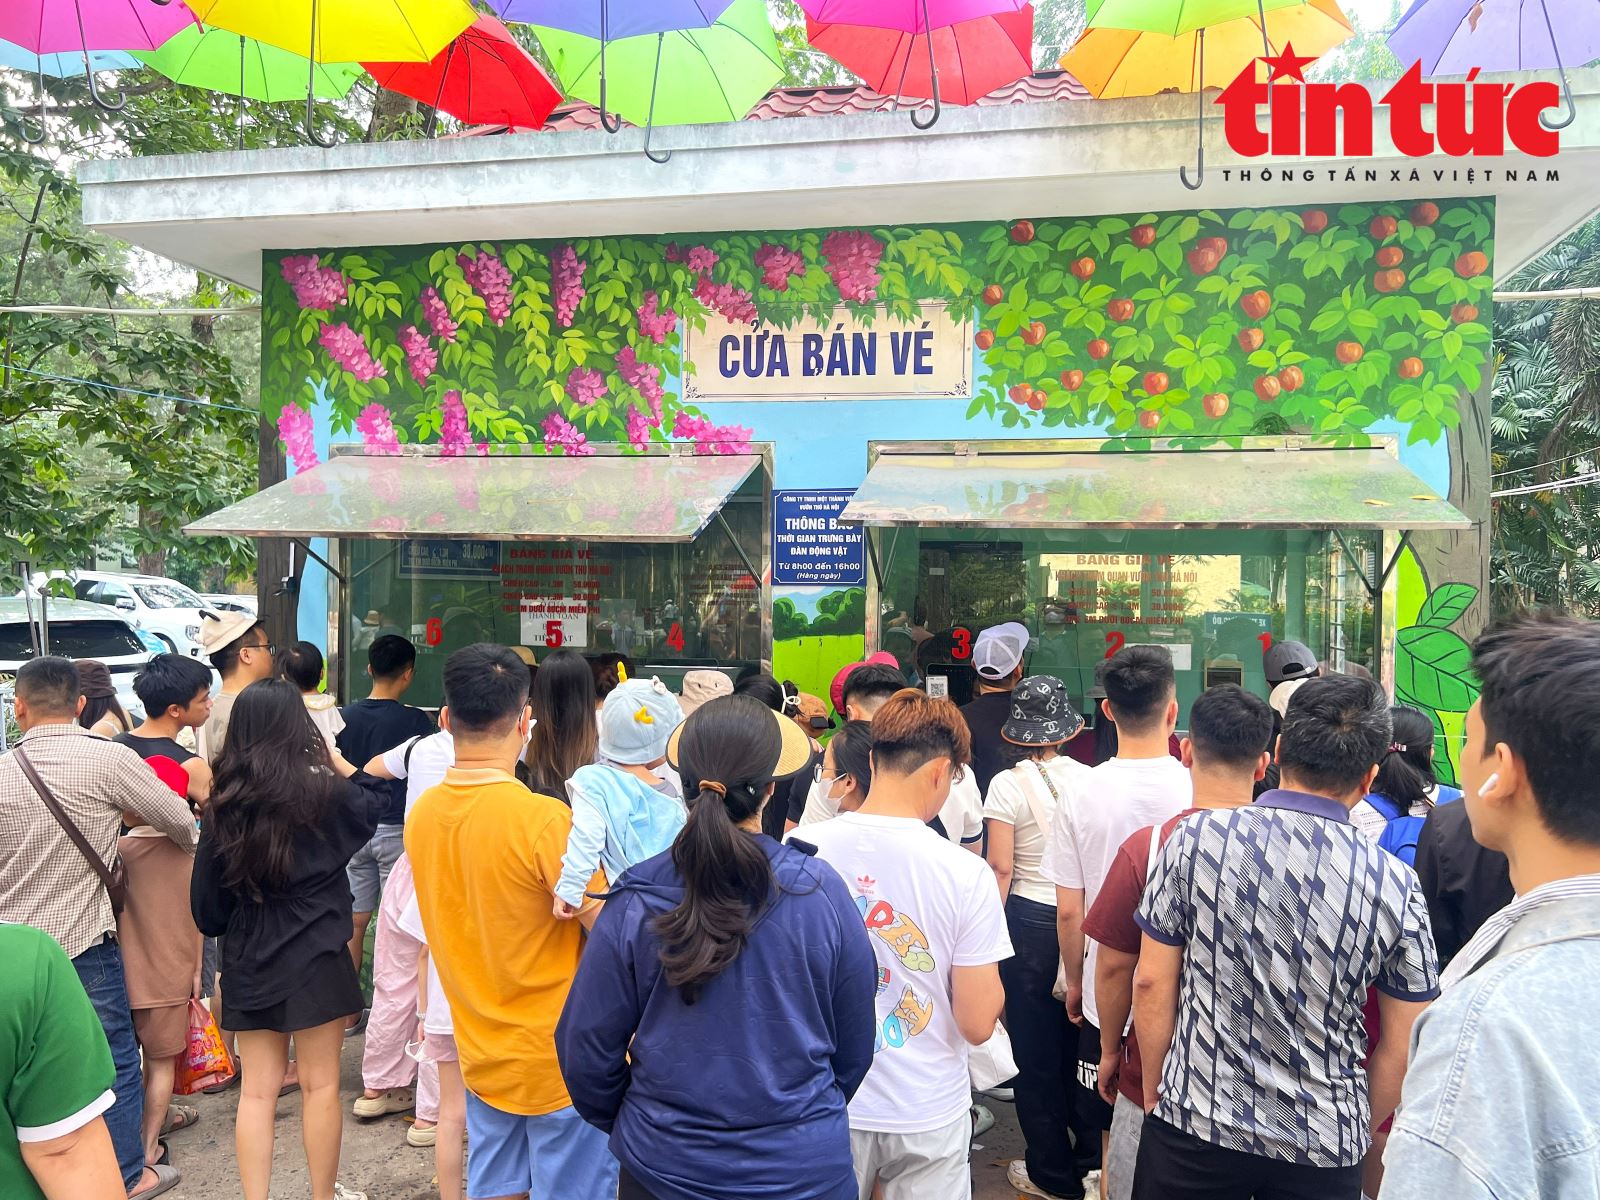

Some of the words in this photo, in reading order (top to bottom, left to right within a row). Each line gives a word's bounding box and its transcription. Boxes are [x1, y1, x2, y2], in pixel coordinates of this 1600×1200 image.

[718, 319, 790, 378] CỬA
[802, 323, 877, 377] BÁN
[890, 321, 934, 375] VÉ
[785, 516, 826, 530] THÔNG
[777, 533, 794, 542] THỜI
[796, 534, 816, 543] GIAN
[818, 534, 844, 543] TRƯNG
[846, 532, 862, 543] BÀY
[790, 546, 807, 556] ĐÀN
[809, 546, 831, 556] ĐỘNG
[833, 546, 848, 556] VẬT
[815, 562, 832, 570] đến
[820, 572, 841, 580] ngày)
[426, 617, 442, 647] 6
[546, 620, 562, 648] 5
[667, 622, 686, 652] 4
[951, 626, 972, 659] 3
[1257, 632, 1272, 656] 1
[1104, 631, 1124, 660] 2
